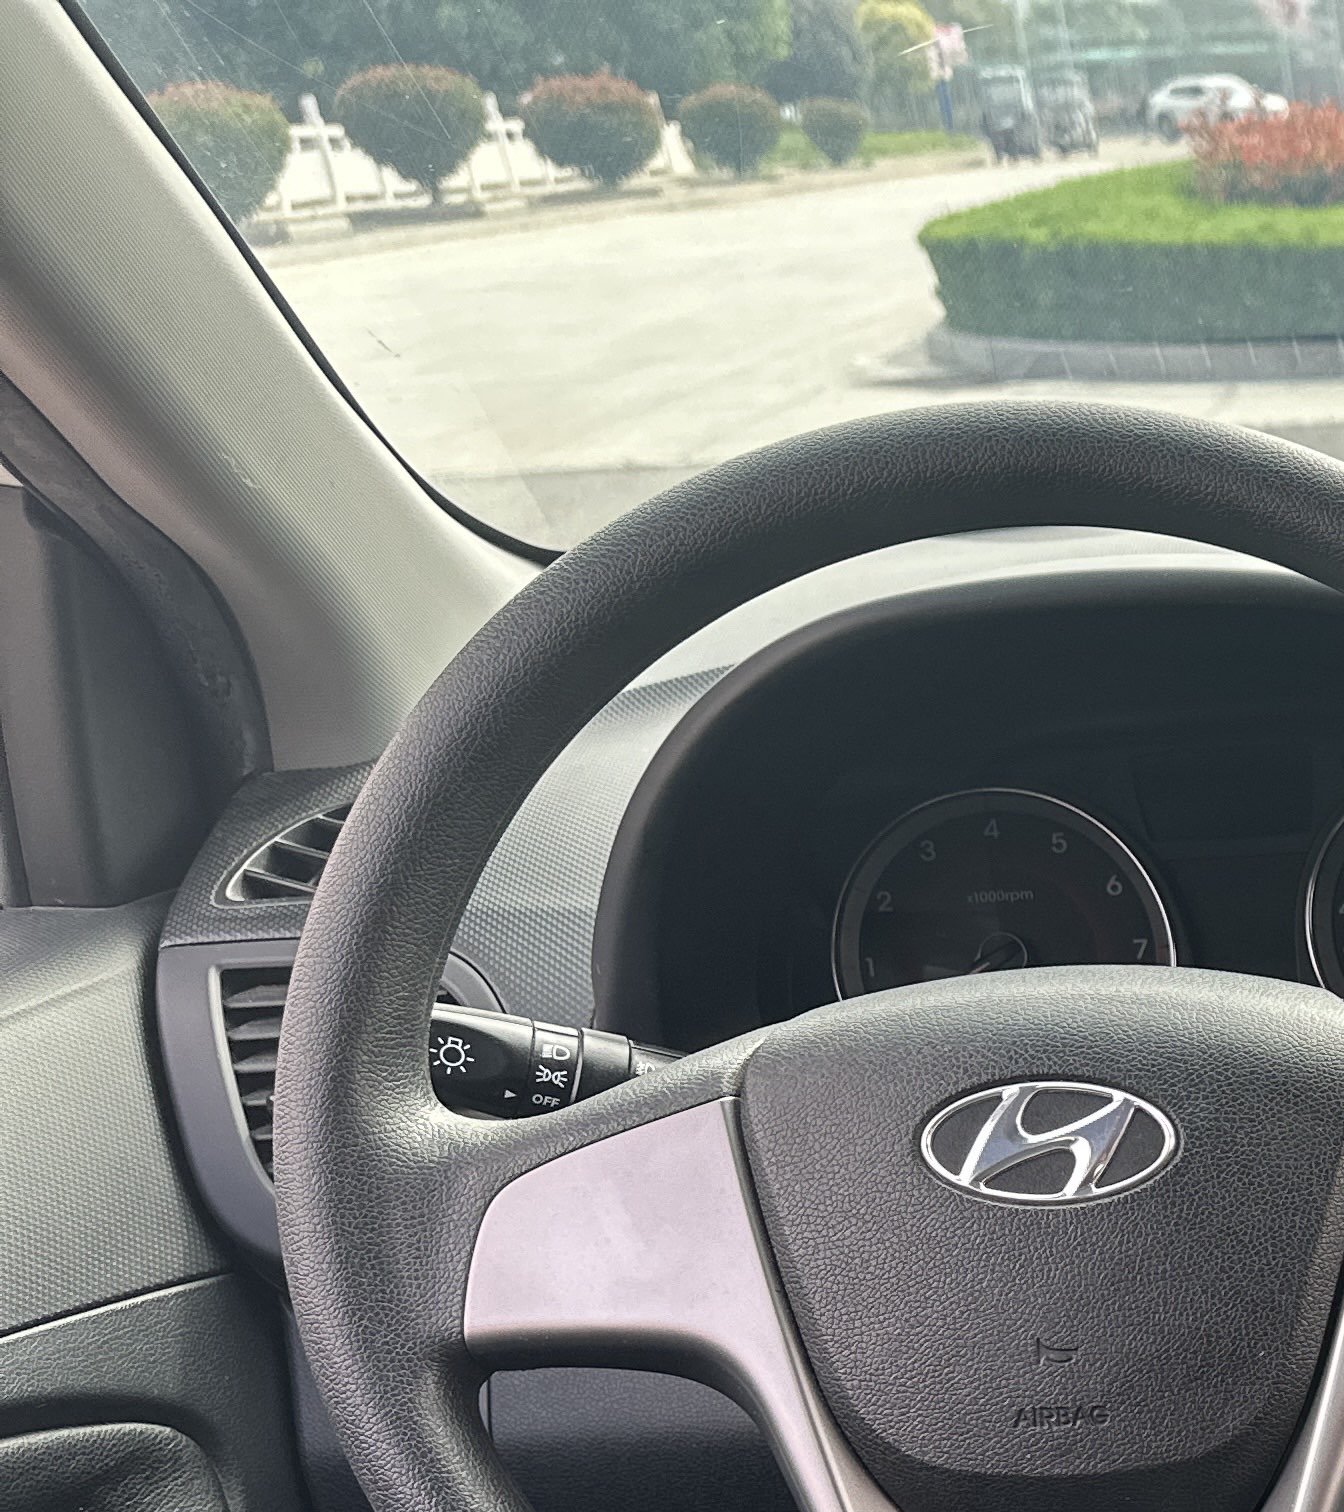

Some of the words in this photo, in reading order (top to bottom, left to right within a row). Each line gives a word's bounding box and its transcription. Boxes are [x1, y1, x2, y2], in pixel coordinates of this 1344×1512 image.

[984, 818, 1000, 840] 4
[920, 840, 937, 862] 3
[1051, 832, 1068, 854] 5
[1106, 875, 1123, 897] 6
[876, 891, 894, 912] 2
[1132, 938, 1149, 960] 7
[864, 957, 875, 978] 1
[532, 1093, 560, 1108] OFF
[1012, 1404, 1112, 1429] AIRBAG
